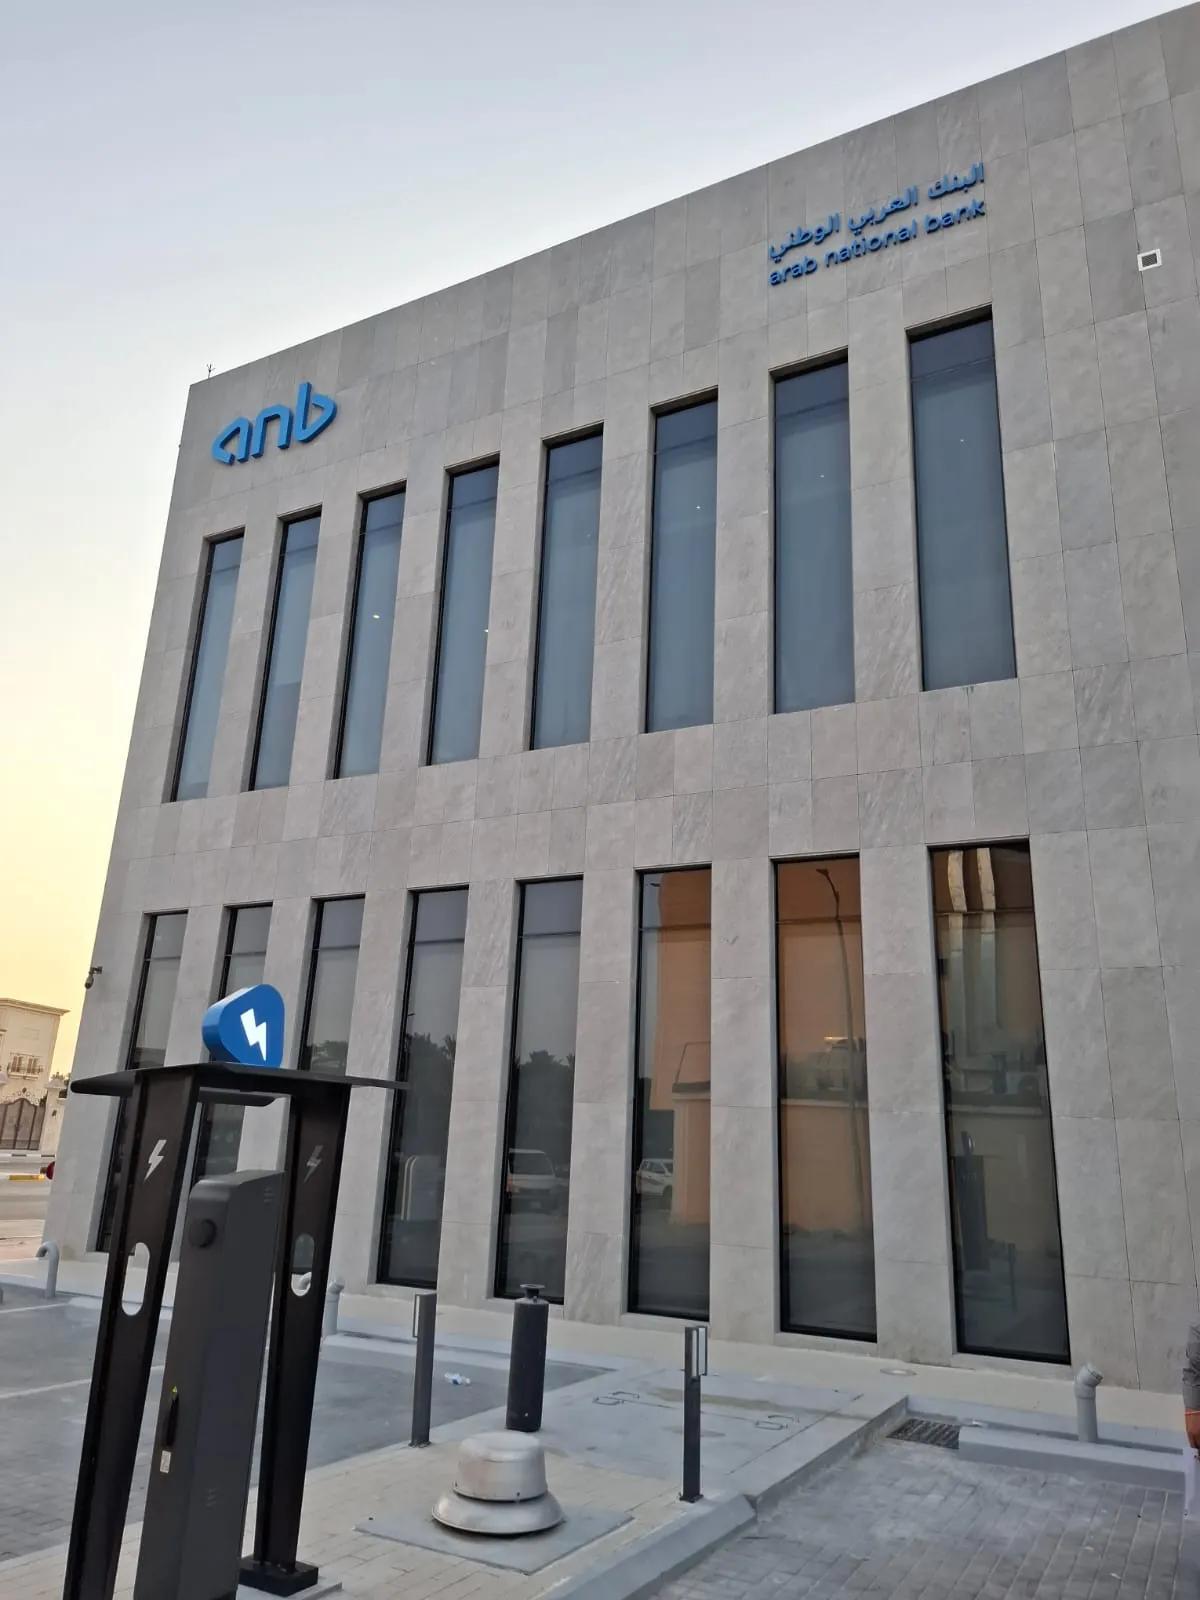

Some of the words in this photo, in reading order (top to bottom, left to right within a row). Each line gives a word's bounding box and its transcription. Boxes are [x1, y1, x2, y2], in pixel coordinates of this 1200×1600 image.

[928, 162, 985, 199] البنك
[848, 185, 918, 235] العربي
[768, 213, 841, 263] الوطني
[768, 256, 818, 285] arab
[824, 219, 918, 267] national
[924, 198, 985, 234] bank
[211, 381, 338, 466] anb
